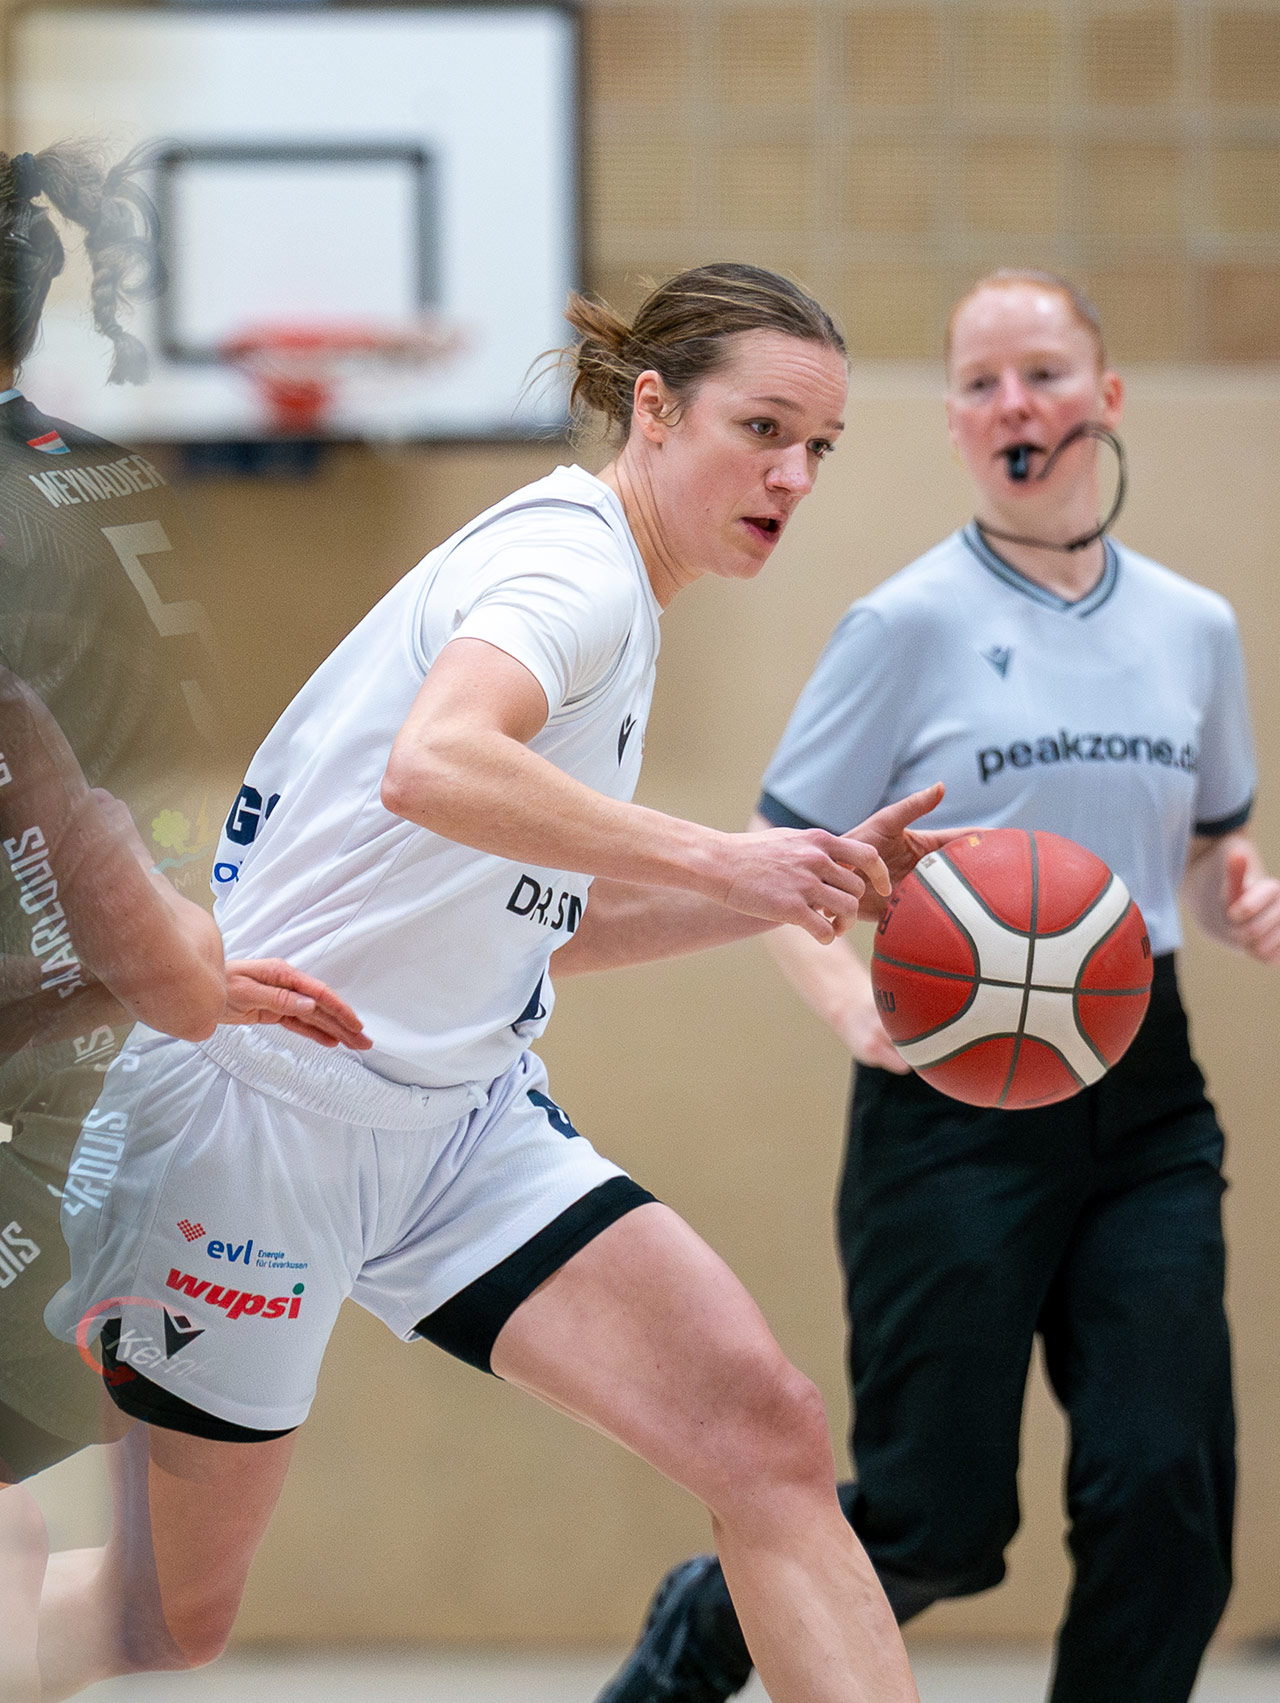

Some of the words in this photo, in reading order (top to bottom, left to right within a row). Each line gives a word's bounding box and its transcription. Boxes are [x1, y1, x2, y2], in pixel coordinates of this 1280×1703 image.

[29, 454, 167, 508] MEYNADIER
[207, 1239, 254, 1265] evl
[256, 1258, 267, 1268] für
[268, 1259, 309, 1270] Leverkusen
[257, 1249, 285, 1260] Energie
[166, 1267, 305, 1320] wupsi
